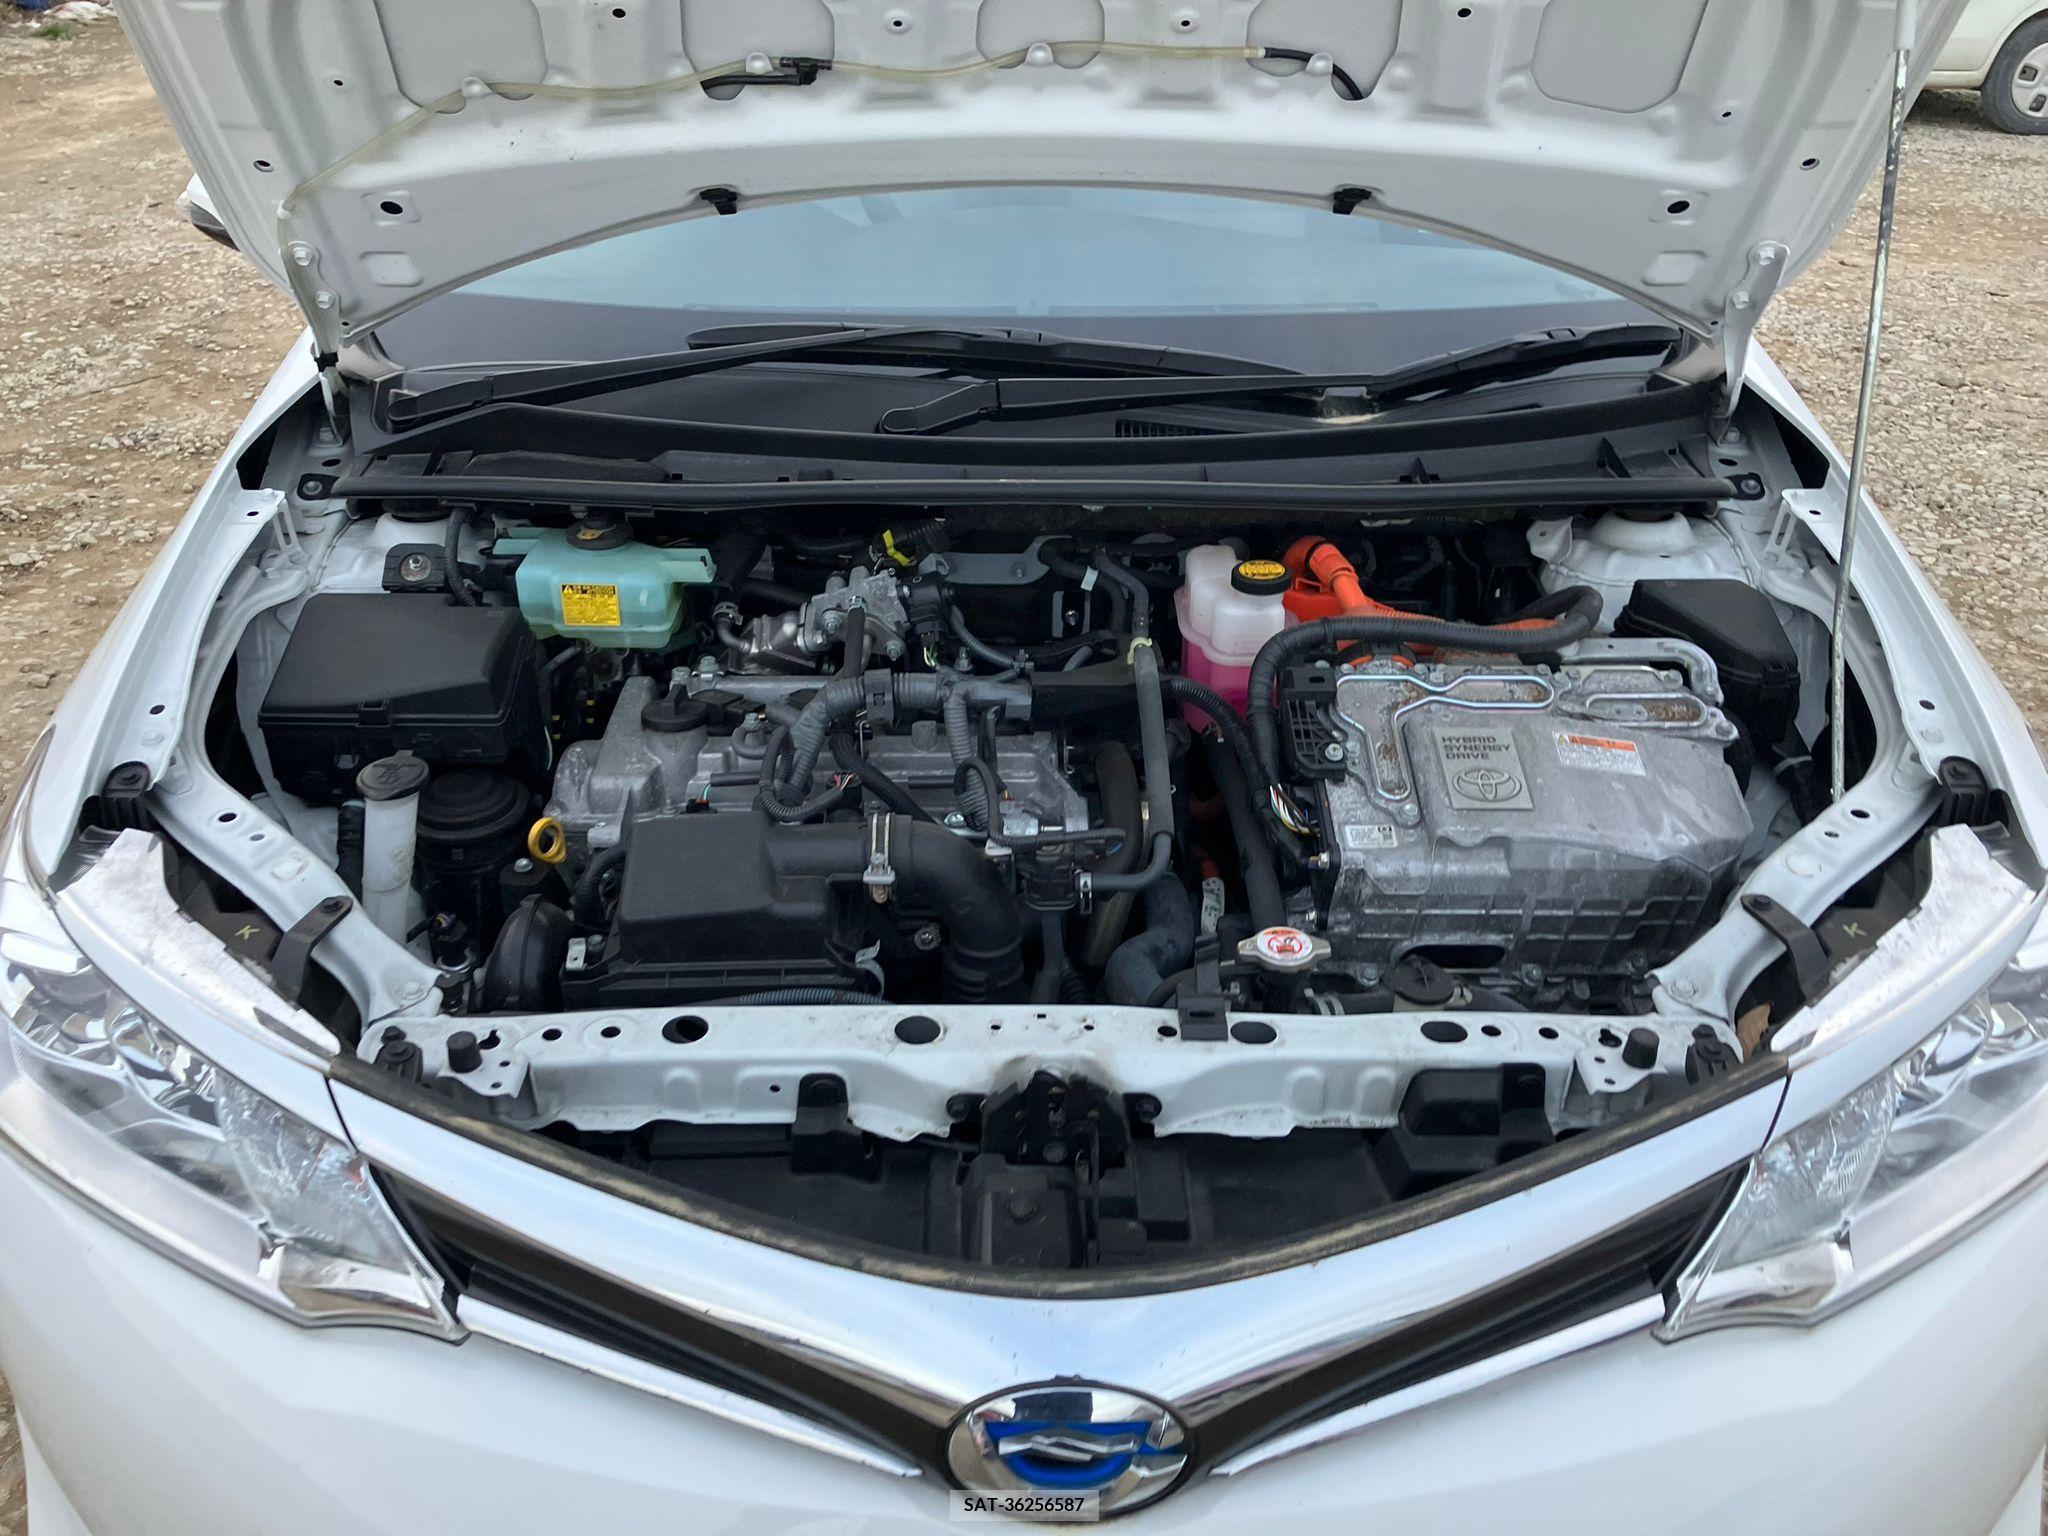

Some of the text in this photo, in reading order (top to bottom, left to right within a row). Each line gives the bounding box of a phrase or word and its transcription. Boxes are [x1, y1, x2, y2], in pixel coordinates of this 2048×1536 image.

[1441, 736, 1497, 744] HYBRID
[1443, 743, 1511, 752] SYNERGY
[1446, 752, 1490, 760] DRIVE
